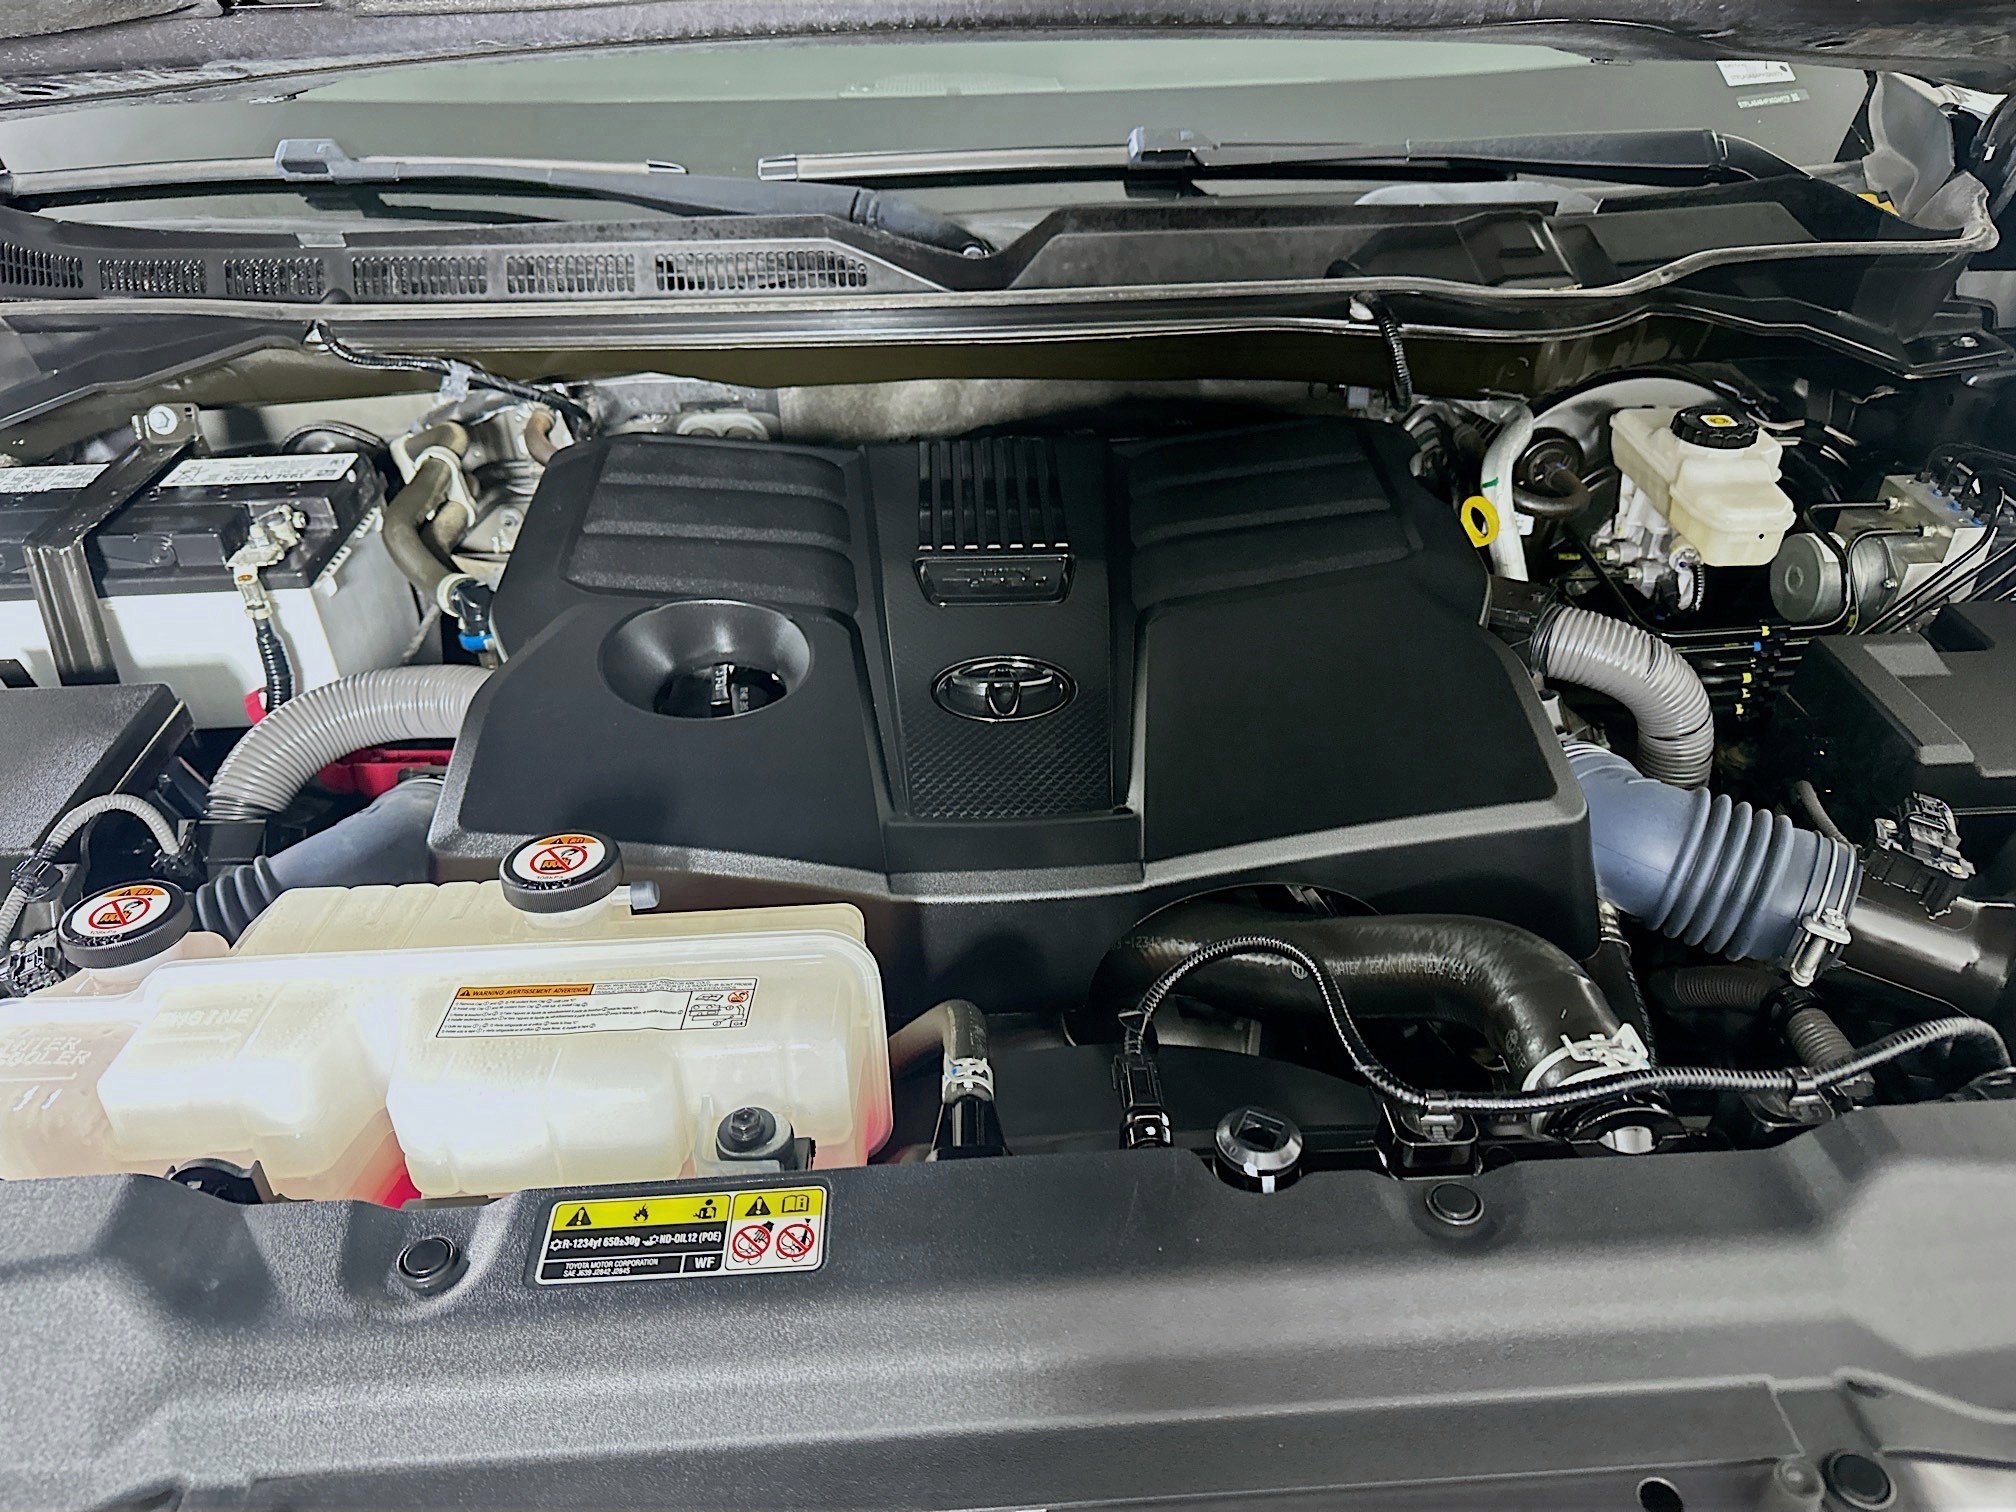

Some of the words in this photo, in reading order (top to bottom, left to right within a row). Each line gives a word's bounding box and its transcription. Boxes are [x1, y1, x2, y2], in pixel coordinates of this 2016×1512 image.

[472, 989, 505, 997] WARNING
[562, 1237, 602, 1250] R-1234yf
[698, 1230, 722, 1244] (POE)
[565, 1262, 590, 1270] TOYOTA
[590, 1261, 613, 1269] MOTOR
[614, 1258, 659, 1268] CORPORATION
[694, 1256, 716, 1269] WF
[563, 1269, 576, 1278] SAE
